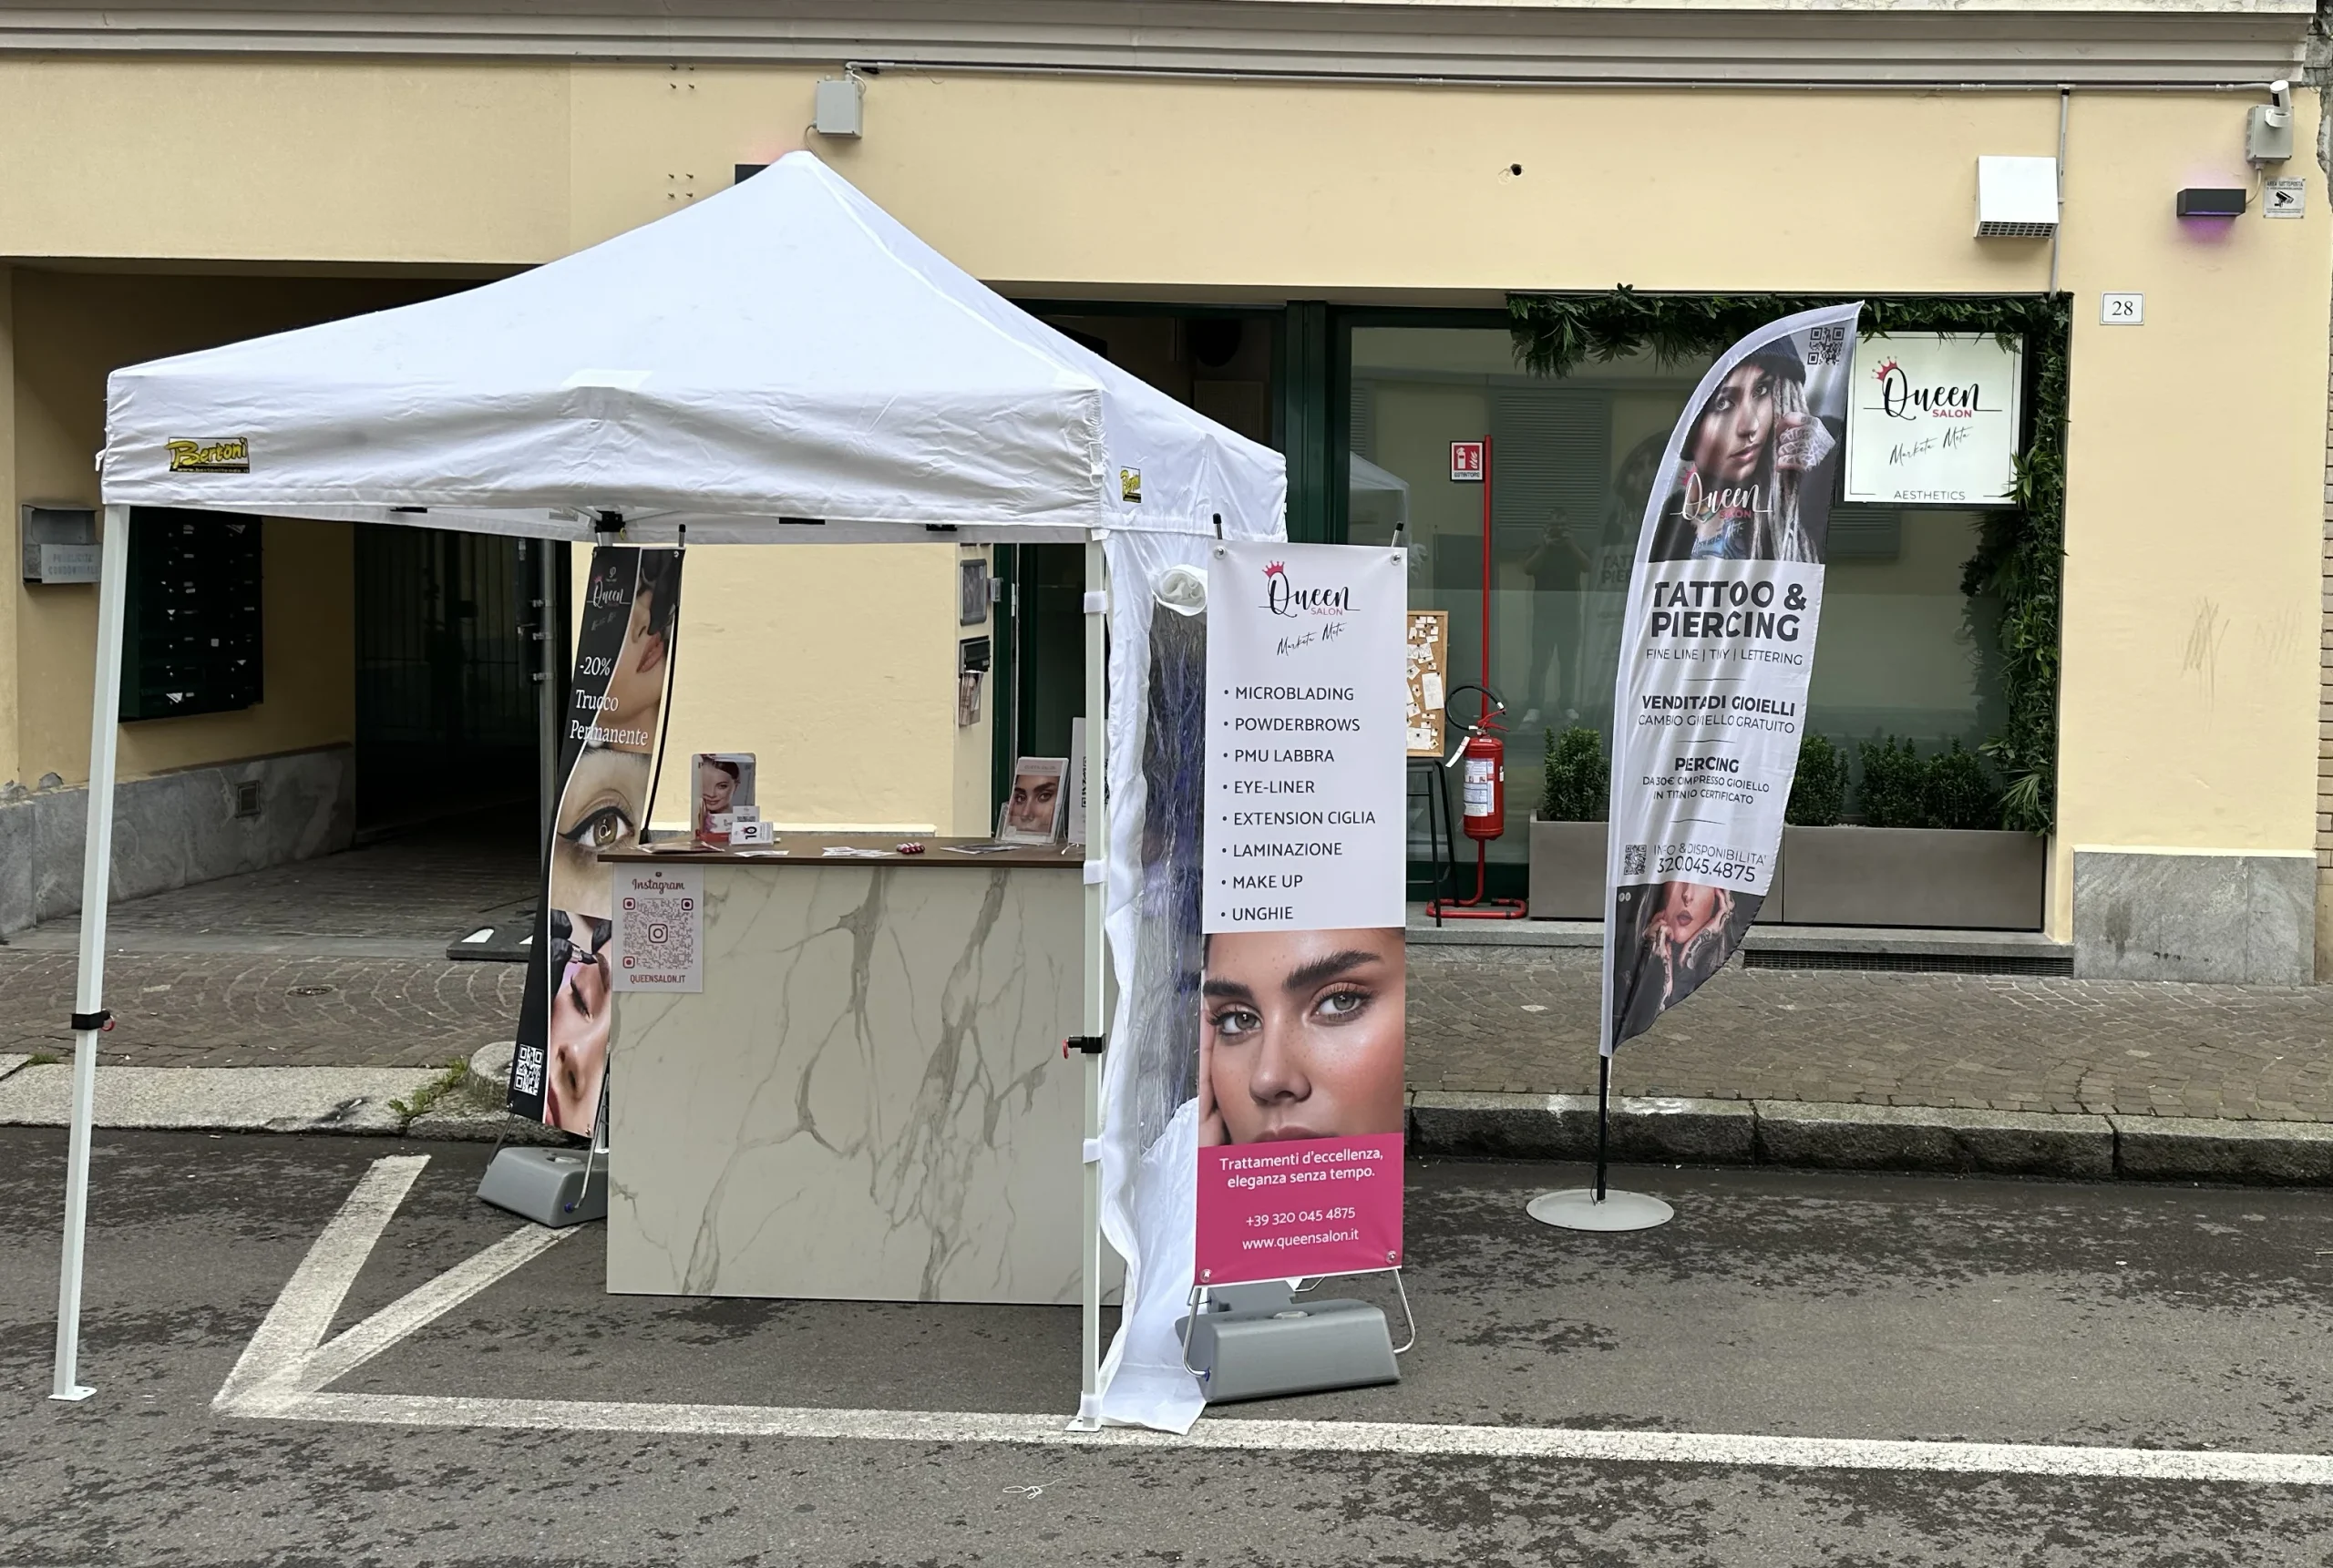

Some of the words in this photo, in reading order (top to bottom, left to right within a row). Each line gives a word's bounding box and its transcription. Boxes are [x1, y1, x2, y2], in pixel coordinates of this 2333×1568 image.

[2112, 301, 2133, 316] 28
[1863, 366, 2002, 421] Queen
[1932, 409, 1972, 418] SALON
[165, 437, 248, 469] Bertoni
[1670, 472, 1773, 523] Queen
[1894, 490, 1966, 501] AESTHETICS
[587, 579, 631, 609] Queen
[1259, 571, 1361, 618] Queen
[1654, 580, 1774, 608] TATTOO
[1783, 583, 1807, 611] &
[1310, 608, 1343, 616] SALON
[1651, 610, 1800, 642] PIERCING
[580, 656, 612, 676] -20%
[1646, 649, 1670, 660] FINE
[1674, 649, 1699, 661] LINE
[1741, 649, 1803, 666] LETTERING
[576, 689, 619, 712] Trucco
[1235, 686, 1354, 701] MICROBLADING
[1642, 695, 1707, 710] VENDITA
[1708, 695, 1726, 709] DI
[1732, 695, 1795, 717] GIOIELLI
[570, 720, 648, 745] Permanente
[1235, 718, 1361, 732] POWDERBROWS
[1639, 714, 1683, 726] CAMBIO
[1736, 716, 1794, 734] GRATUITO
[1235, 749, 1269, 763] PMU
[1274, 749, 1334, 763] LABBRA
[1234, 781, 1315, 794] EYE-LINER
[1642, 776, 1654, 785] DA
[1656, 776, 1675, 786] 30€
[1727, 778, 1770, 793] GIOIELLO
[1653, 791, 1663, 800] IN
[1700, 789, 1753, 804] CERTIFICATO
[1234, 812, 1323, 825] EXTENSION
[1328, 811, 1376, 825] CIGLIA
[1233, 843, 1342, 857] LAMINAZIONE
[1679, 843, 1687, 854] &
[632, 878, 685, 895] Instagram
[1233, 875, 1277, 889] MAKE
[1281, 875, 1303, 888] UP
[1233, 907, 1293, 921] UNGHIE
[630, 974, 686, 984] QUEENSALON.IT
[1219, 1153, 1300, 1171] Trattamenti
[1302, 1148, 1383, 1164] d'eccellenza,
[1228, 1173, 1286, 1190] eleganza
[1290, 1170, 1326, 1183] senza
[1330, 1166, 1375, 1182] tempo.
[1246, 1214, 1269, 1227] +39
[1272, 1212, 1295, 1225] 320
[1299, 1210, 1323, 1223] 045
[1326, 1207, 1356, 1221] 4875
[1242, 1228, 1359, 1250] www.queensalon.it
